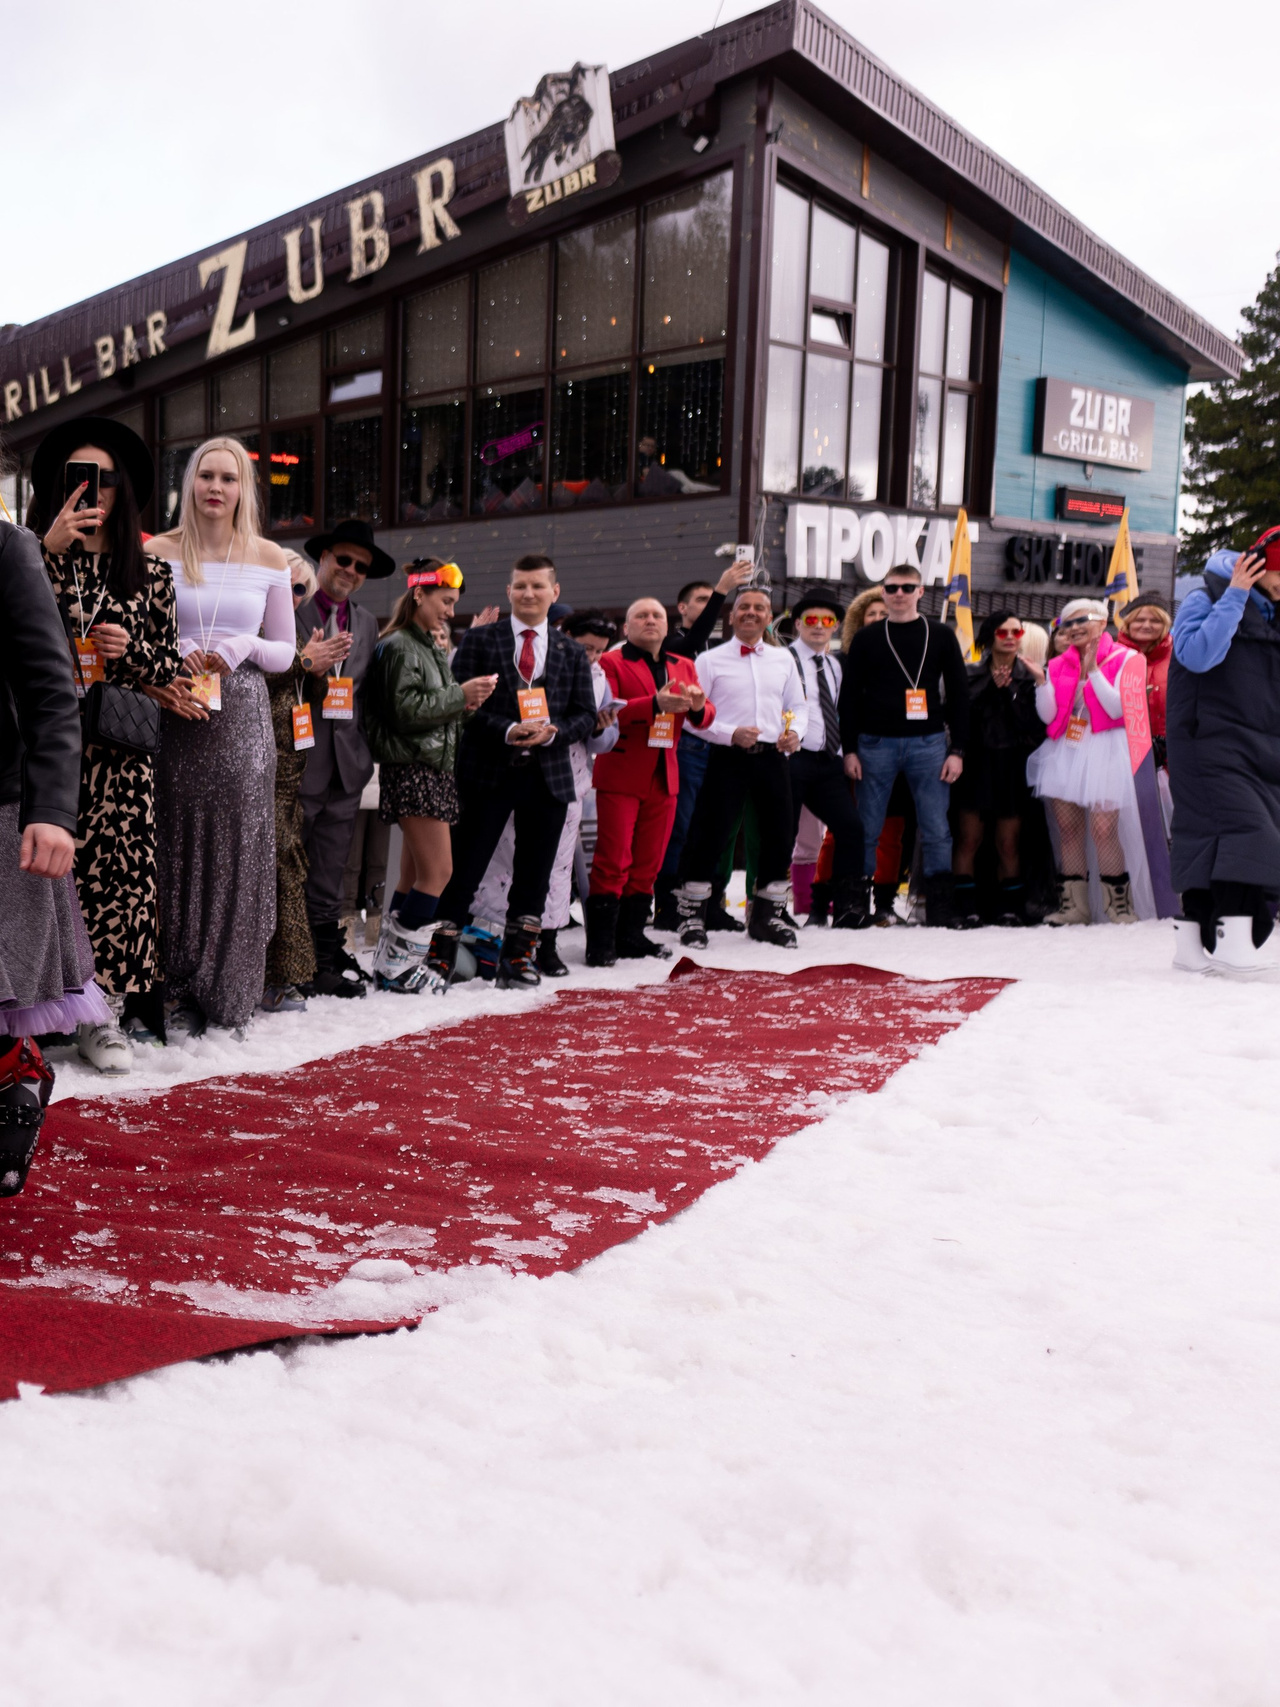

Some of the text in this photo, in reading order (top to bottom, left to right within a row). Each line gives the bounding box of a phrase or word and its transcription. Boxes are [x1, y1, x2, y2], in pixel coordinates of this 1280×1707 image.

[526, 164, 597, 213] ZUBR
[197, 157, 462, 359] ZUBR
[96, 309, 169, 379] BAR
[1070, 387, 1132, 437] ZUBR
[1058, 428, 1139, 463] GRILL BAR
[1070, 541, 1144, 588] HOE
